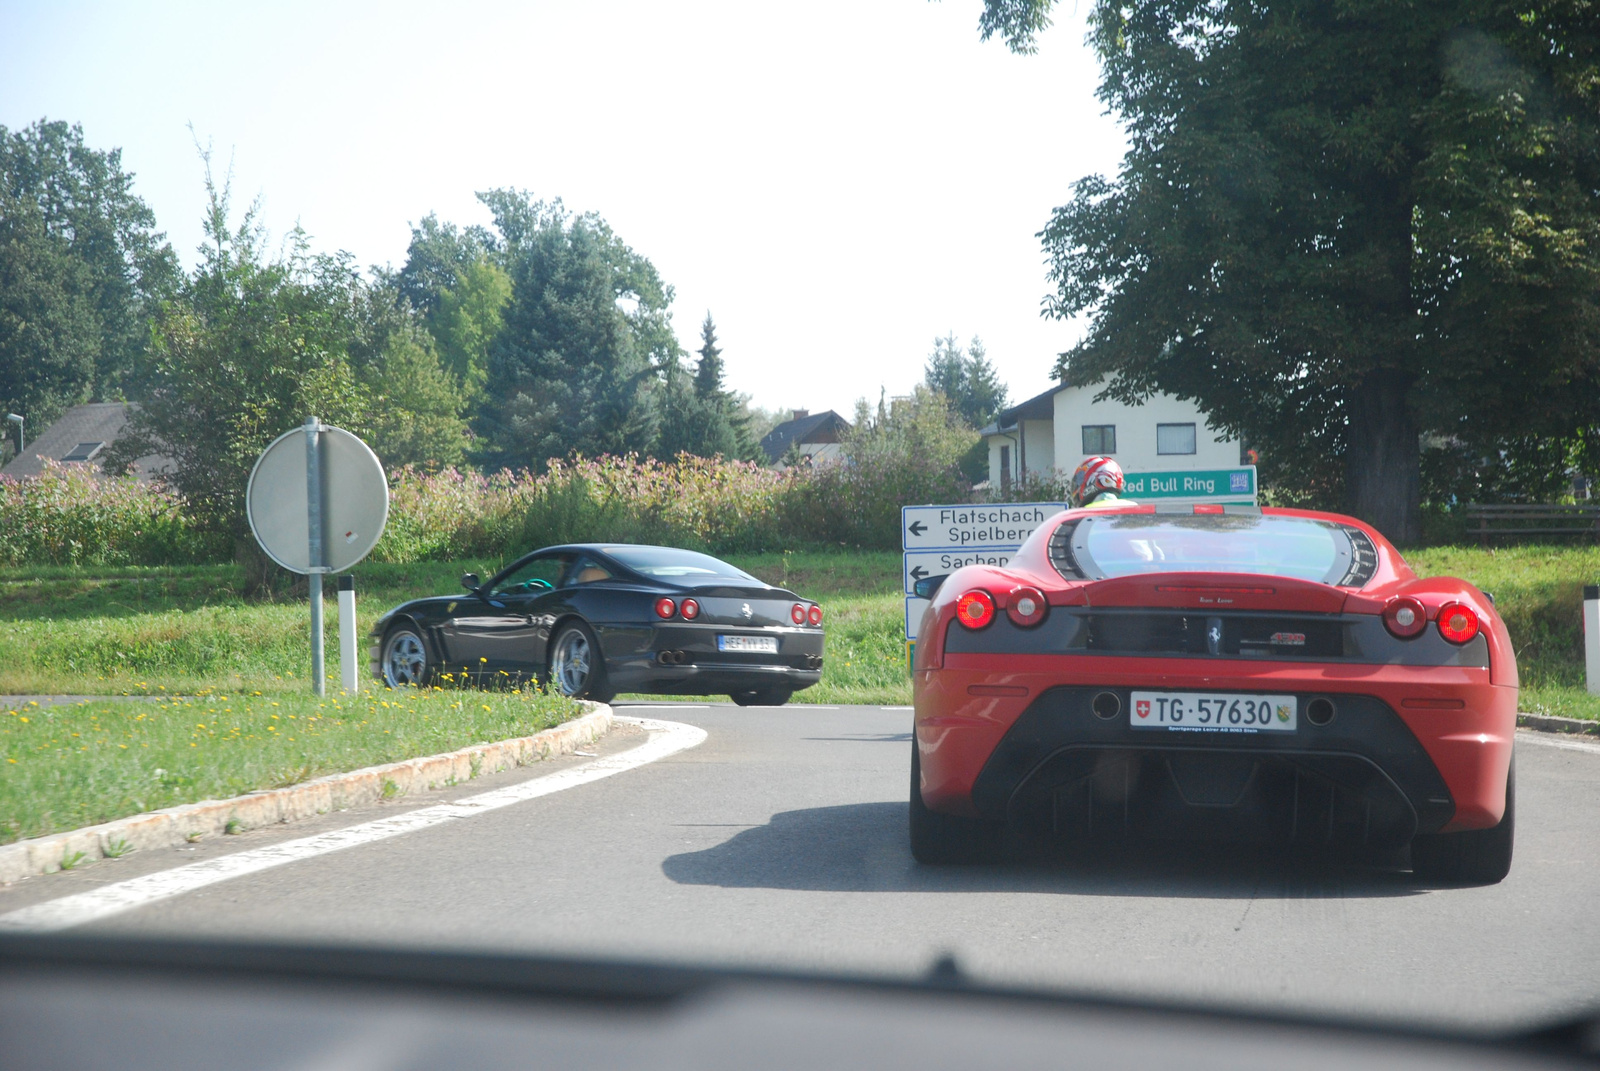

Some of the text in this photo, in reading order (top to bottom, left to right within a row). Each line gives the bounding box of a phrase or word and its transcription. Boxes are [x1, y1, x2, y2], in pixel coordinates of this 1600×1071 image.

[1150, 477, 1178, 492] Bull
[1183, 477, 1215, 493] Ring
[940, 508, 1044, 524] Flatschach
